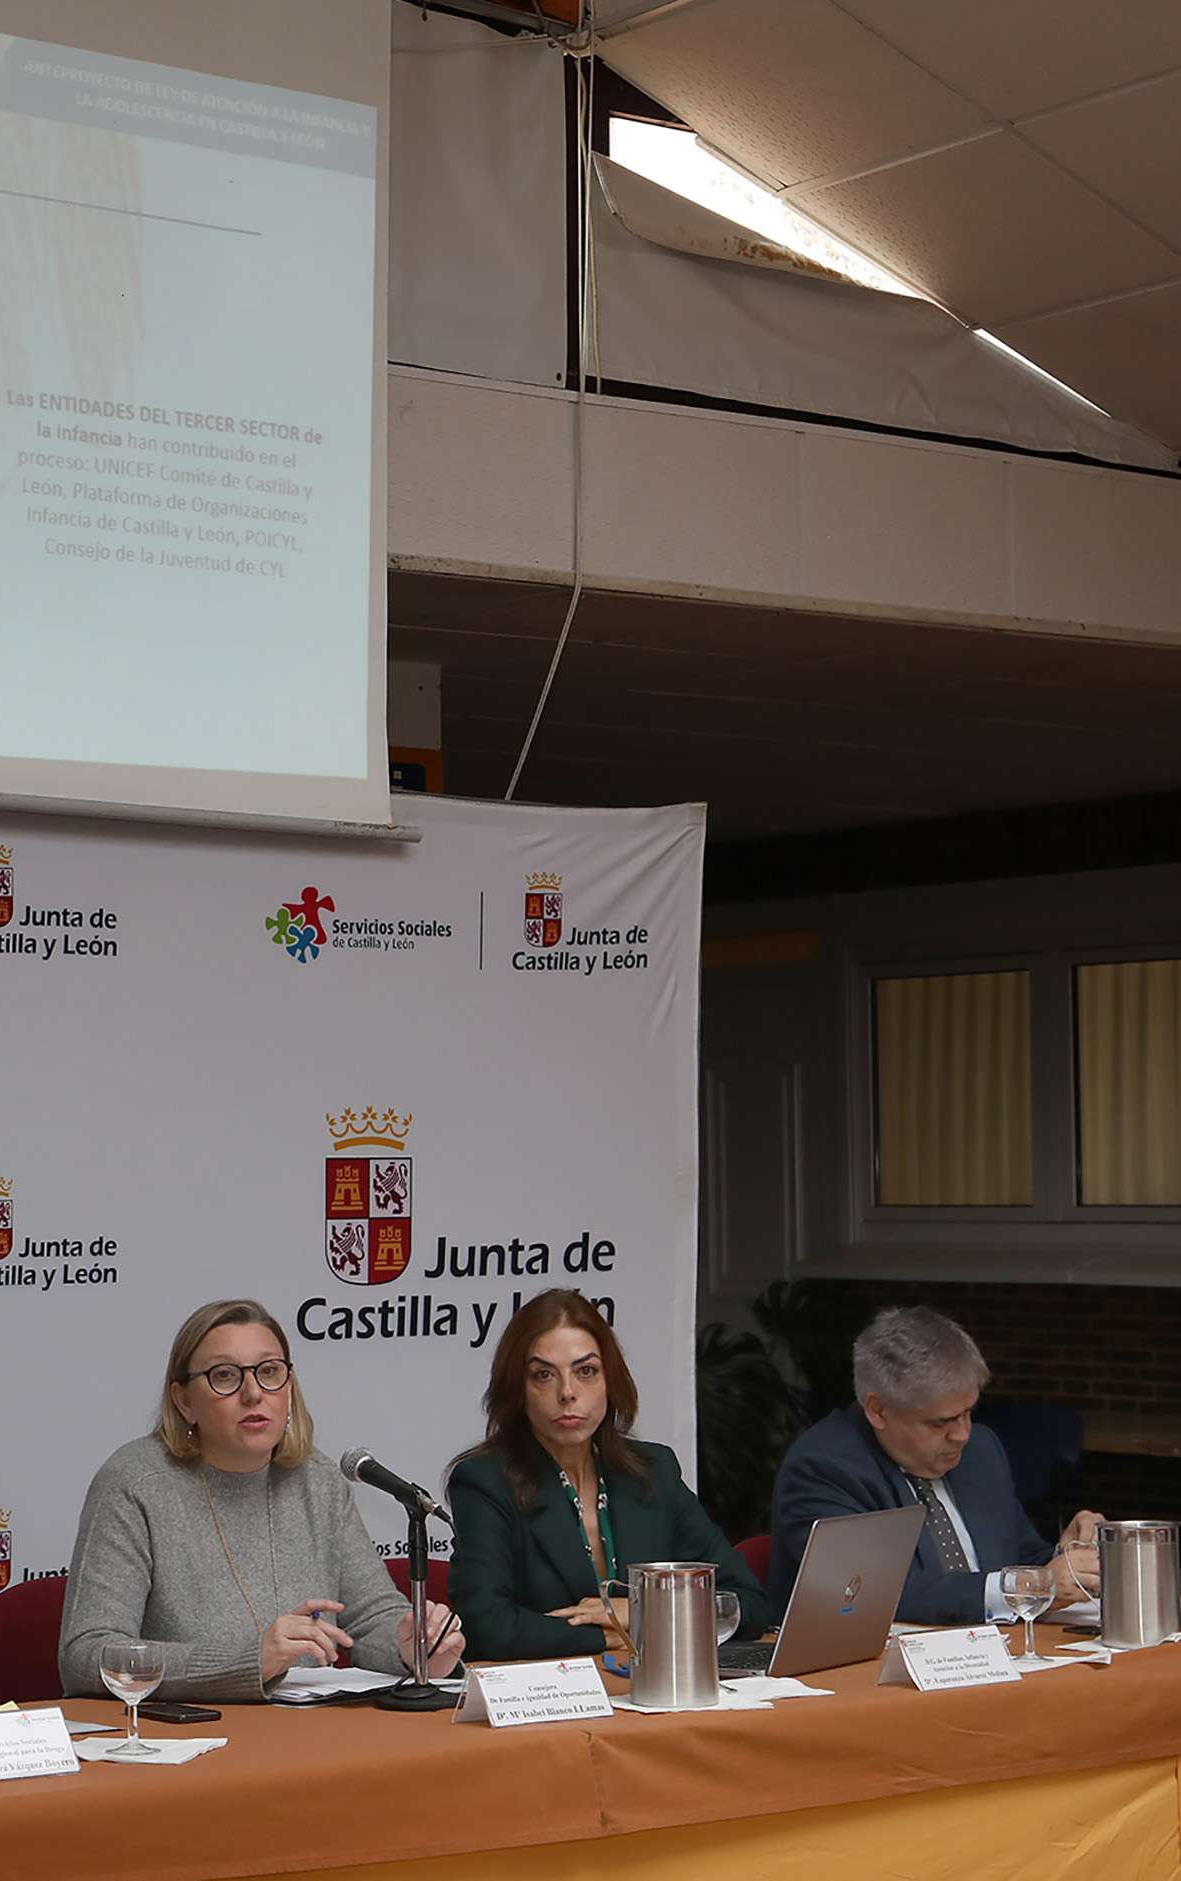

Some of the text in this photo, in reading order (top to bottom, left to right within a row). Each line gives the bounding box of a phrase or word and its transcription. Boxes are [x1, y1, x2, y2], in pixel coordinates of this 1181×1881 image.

[7, 390, 323, 444] Las ENTIDADES DEL TERCER SECTOR de
[37, 421, 297, 470] la infancia han contribuido en el
[18, 450, 313, 500] proceso: UNICEF Comité de Castilla y
[22, 478, 308, 525] León, Plataforma de Organizaciones
[27, 506, 303, 554] Infancia de Castilla y León, POICYL,
[45, 538, 287, 578] Consejo de la Juventud de CYL
[18, 905, 117, 928] Junta de
[332, 919, 452, 937] Servicios Sociales
[42, 939, 57, 960] y
[63, 934, 118, 957] León
[332, 936, 414, 951] de Castilla y León
[566, 925, 648, 946] Junta de
[512, 950, 648, 976] Castilla y León
[18, 1236, 117, 1258] Junta de
[424, 1232, 616, 1279] Junta de
[42, 1269, 56, 1290] y
[63, 1263, 118, 1285] León
[296, 1296, 457, 1341] Castilla
[470, 1302, 497, 1348] y
[395, 1536, 448, 1555] Soles
[528, 1684, 557, 1693] Consejera
[523, 1709, 545, 1718] Isabel
[547, 1707, 573, 1716] Blanco
[45, 1759, 75, 1769] Boyero
